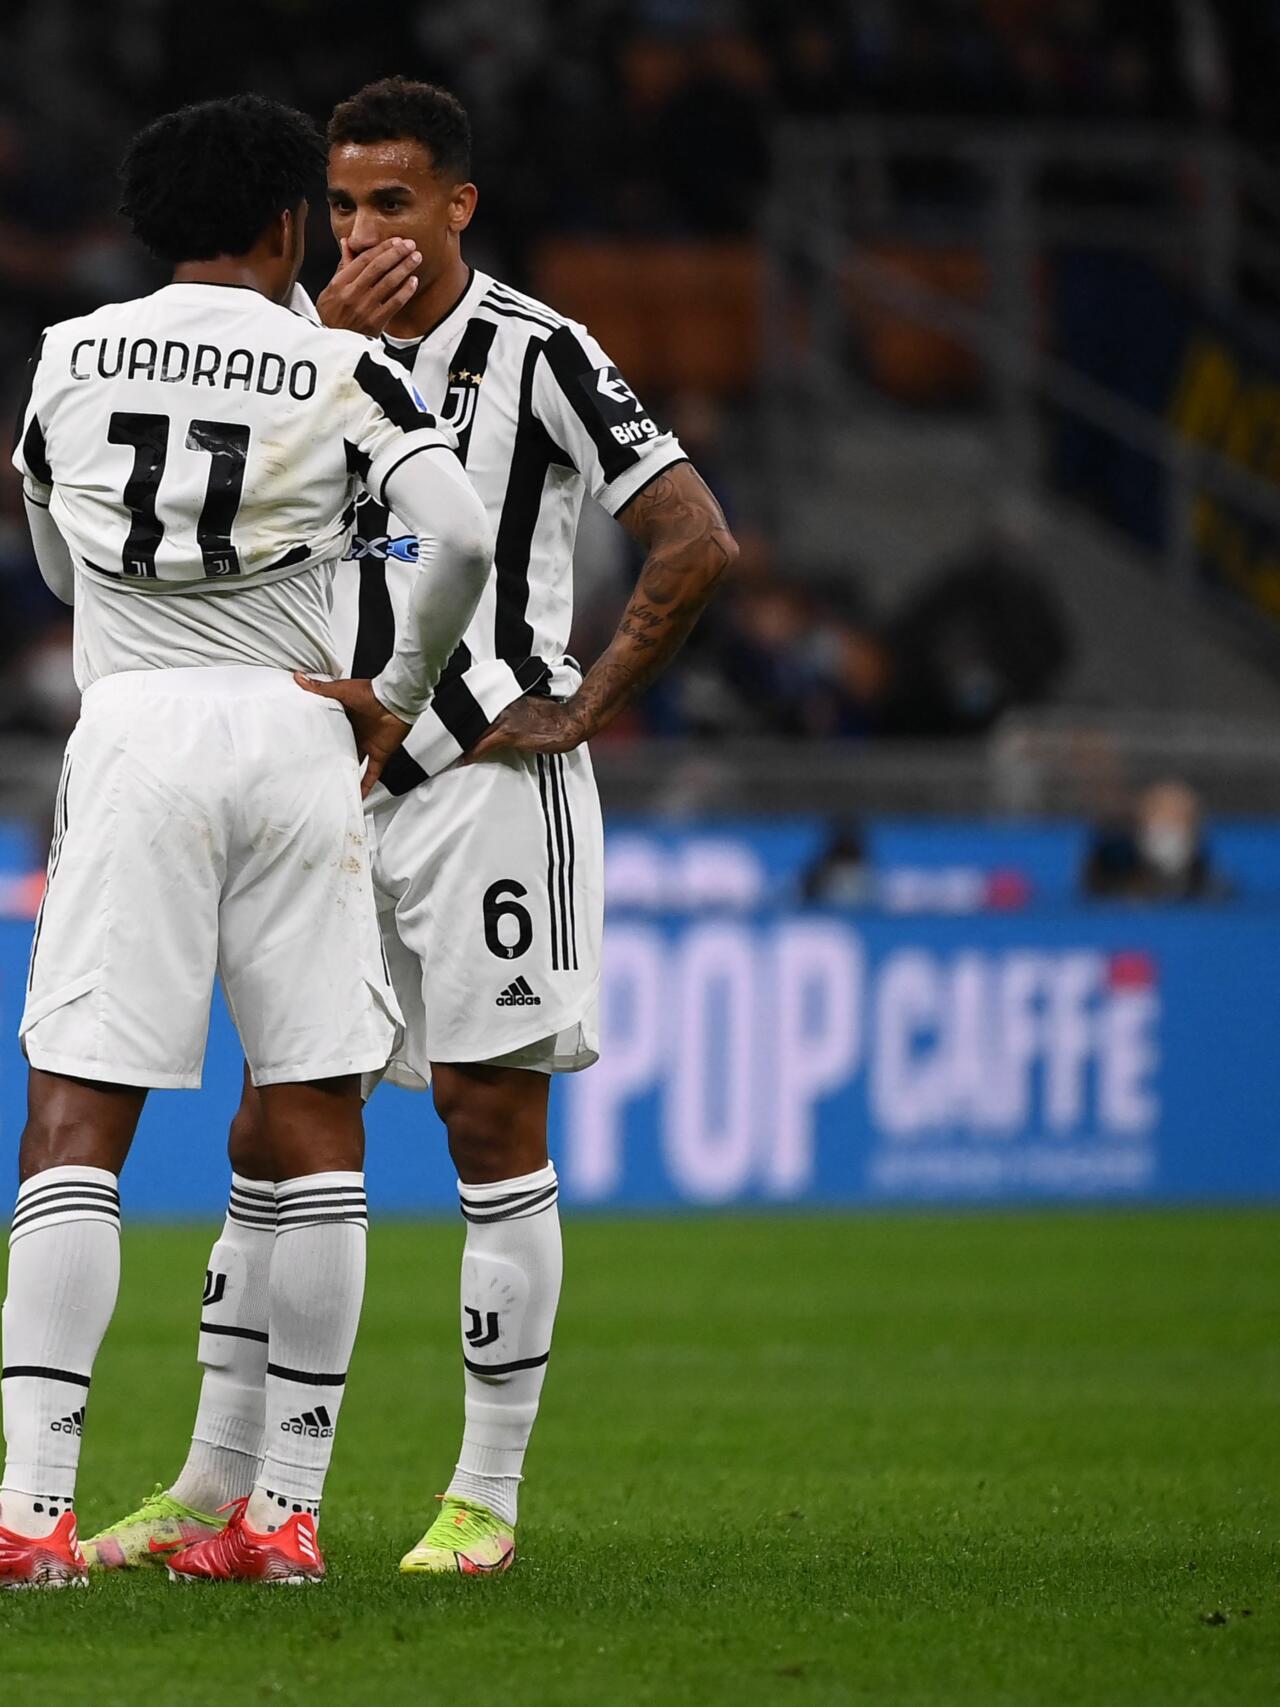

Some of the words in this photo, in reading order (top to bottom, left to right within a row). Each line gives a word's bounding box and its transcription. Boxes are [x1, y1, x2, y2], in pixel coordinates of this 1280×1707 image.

[69, 336, 318, 401] CUADRADO
[106, 411, 252, 578] 11
[482, 878, 533, 960] 6
[495, 993, 541, 1007] adidas
[280, 1420, 334, 1438] adidas
